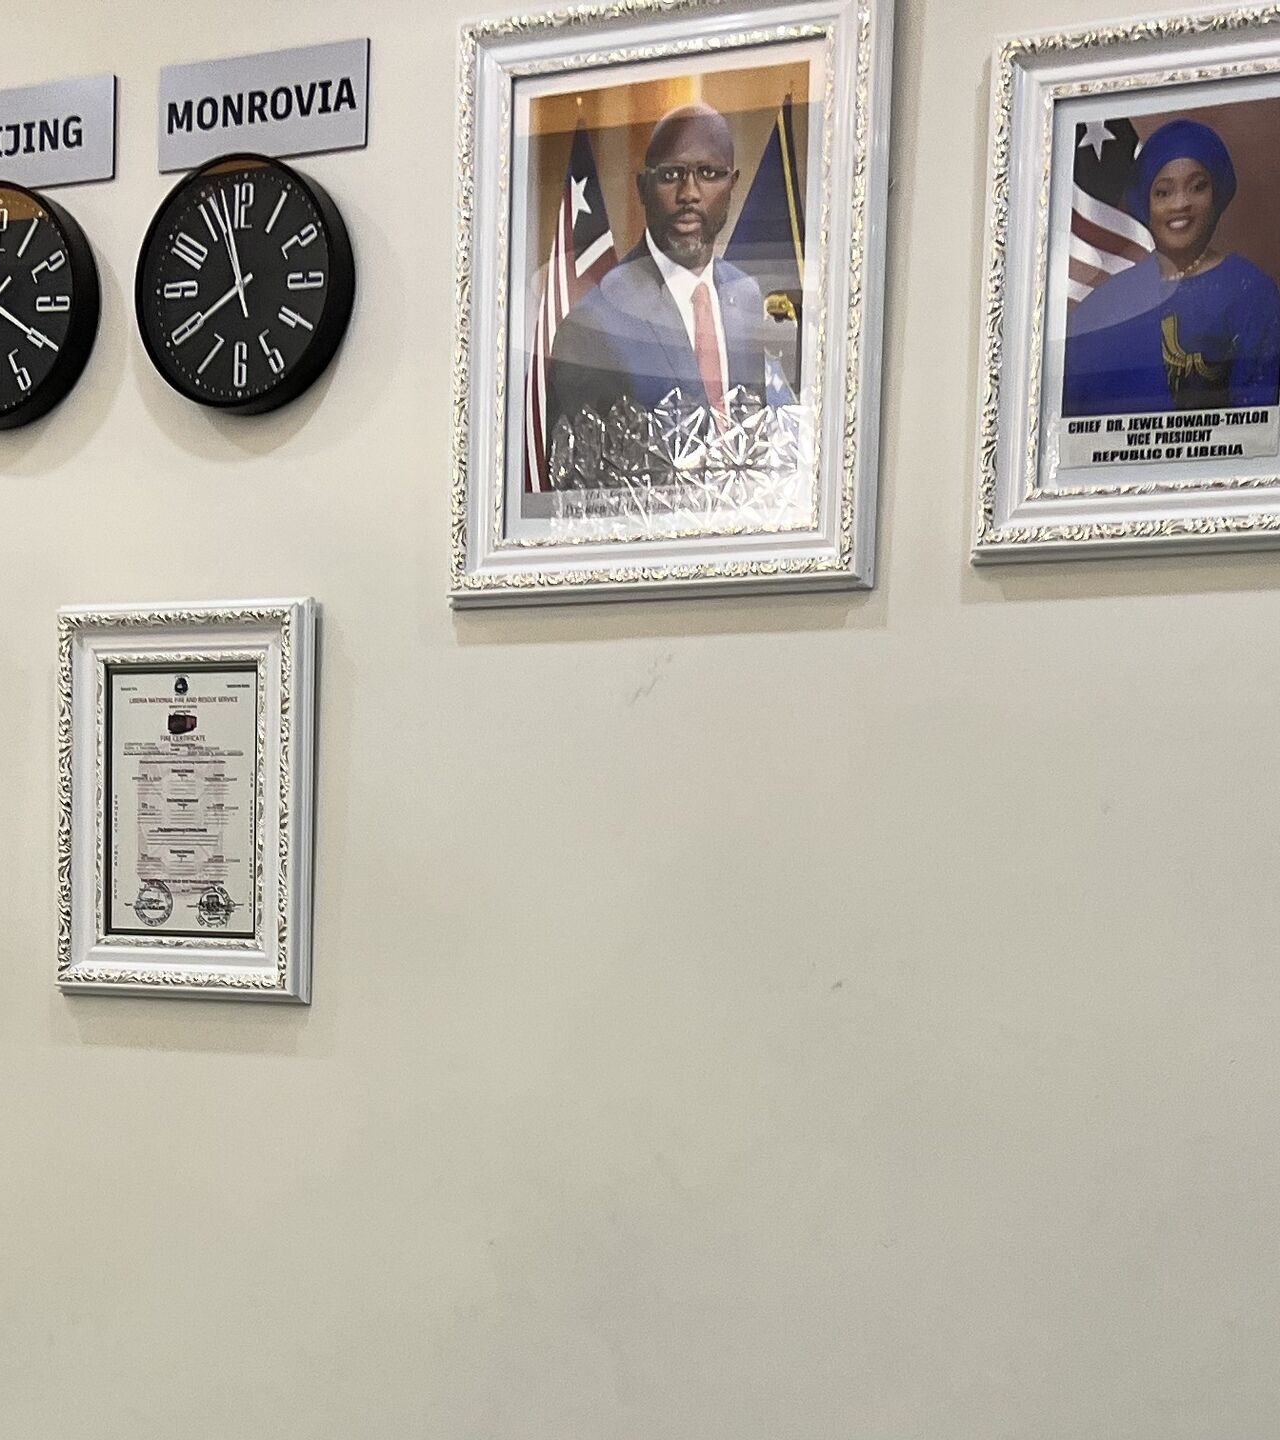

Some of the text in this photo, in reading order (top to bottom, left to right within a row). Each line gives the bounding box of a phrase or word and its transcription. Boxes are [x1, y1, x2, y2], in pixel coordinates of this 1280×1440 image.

[166, 77, 358, 135] MONROVIA
[233, 182, 255, 229] 12
[265, 189, 288, 233] 1
[16, 217, 39, 258] 1
[281, 223, 318, 260] 2
[31, 250, 66, 284] 2
[287, 271, 324, 291] 3
[36, 295, 70, 312] 3
[163, 279, 199, 298] 9
[171, 311, 204, 345] 8
[277, 305, 314, 331] 4
[26, 327, 59, 352] 4
[197, 332, 225, 375] 7
[258, 328, 285, 374] 5
[8, 349, 32, 391] 5
[233, 341, 248, 388] 6
[1068, 410, 1269, 434] CHIEF DR. JEWEL HOWARD-TAYLOR
[1127, 429, 1212, 446] VICE PRESIDENT
[1092, 444, 1244, 463] REPUBLIC OF LIBERIA
